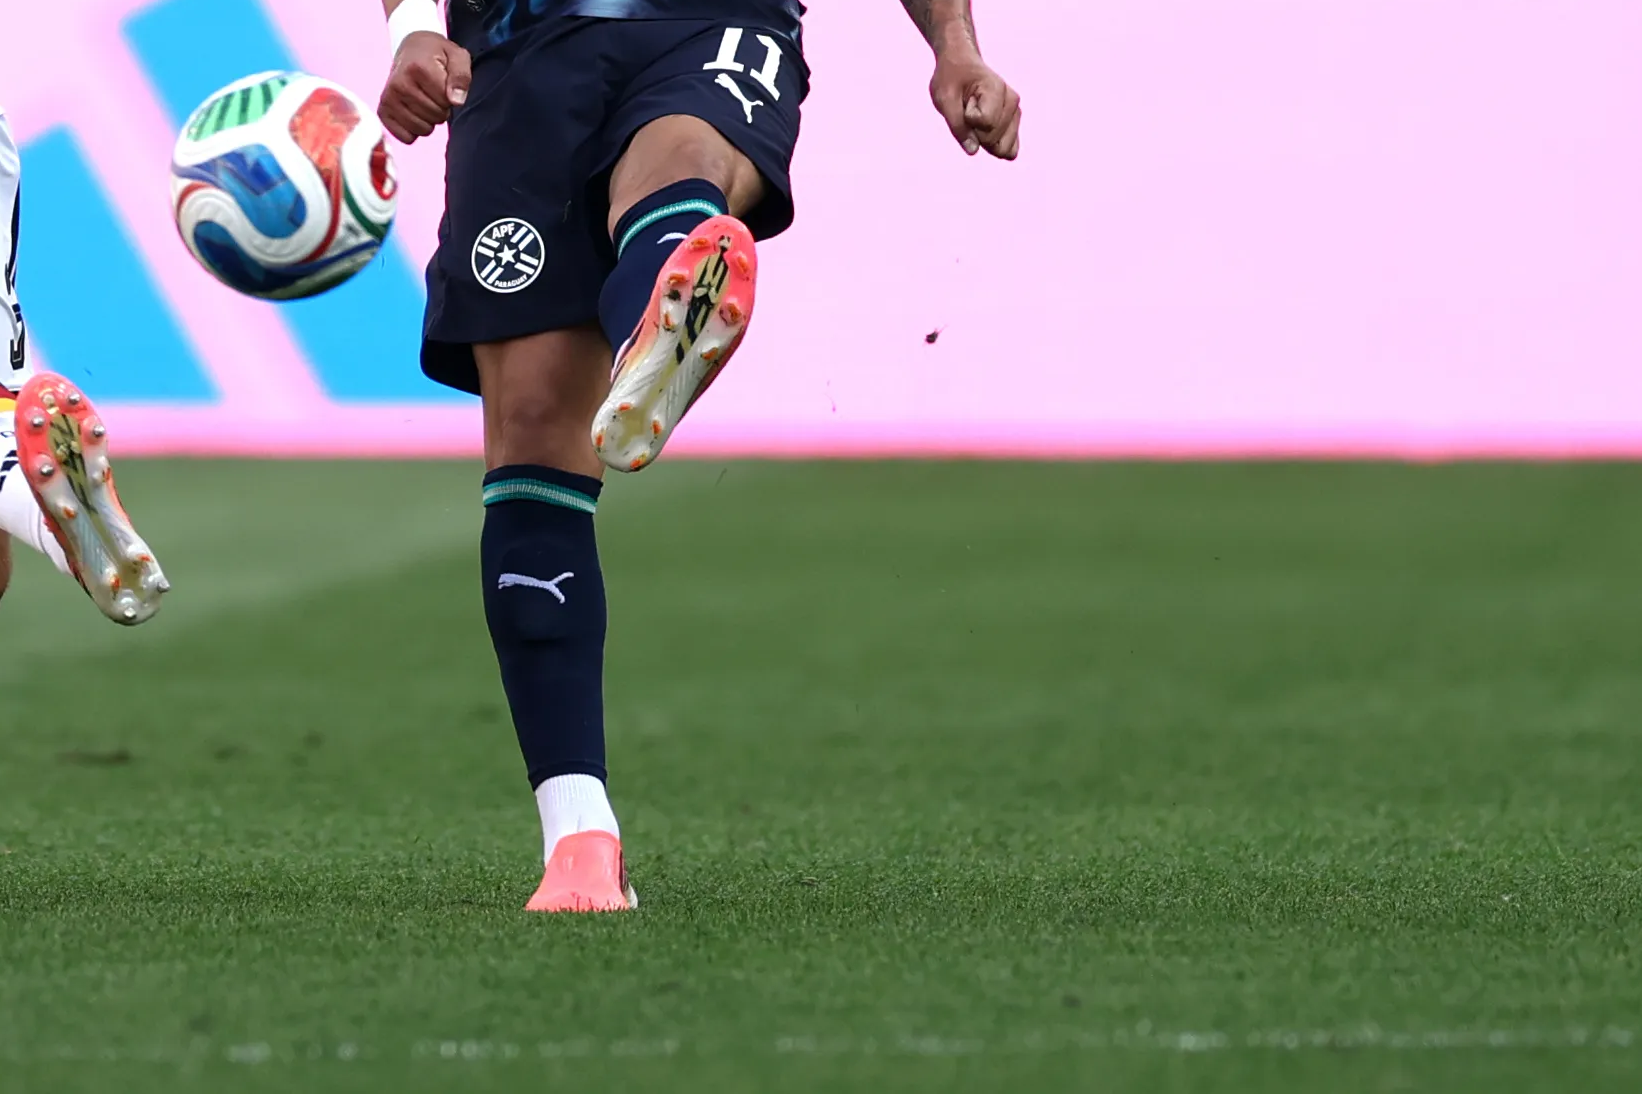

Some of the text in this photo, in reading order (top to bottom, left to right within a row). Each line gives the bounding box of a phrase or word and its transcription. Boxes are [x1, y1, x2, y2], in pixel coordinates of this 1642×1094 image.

[702, 27, 784, 102] 11
[492, 222, 516, 240] APF
[494, 273, 528, 288] PARAGUAY
